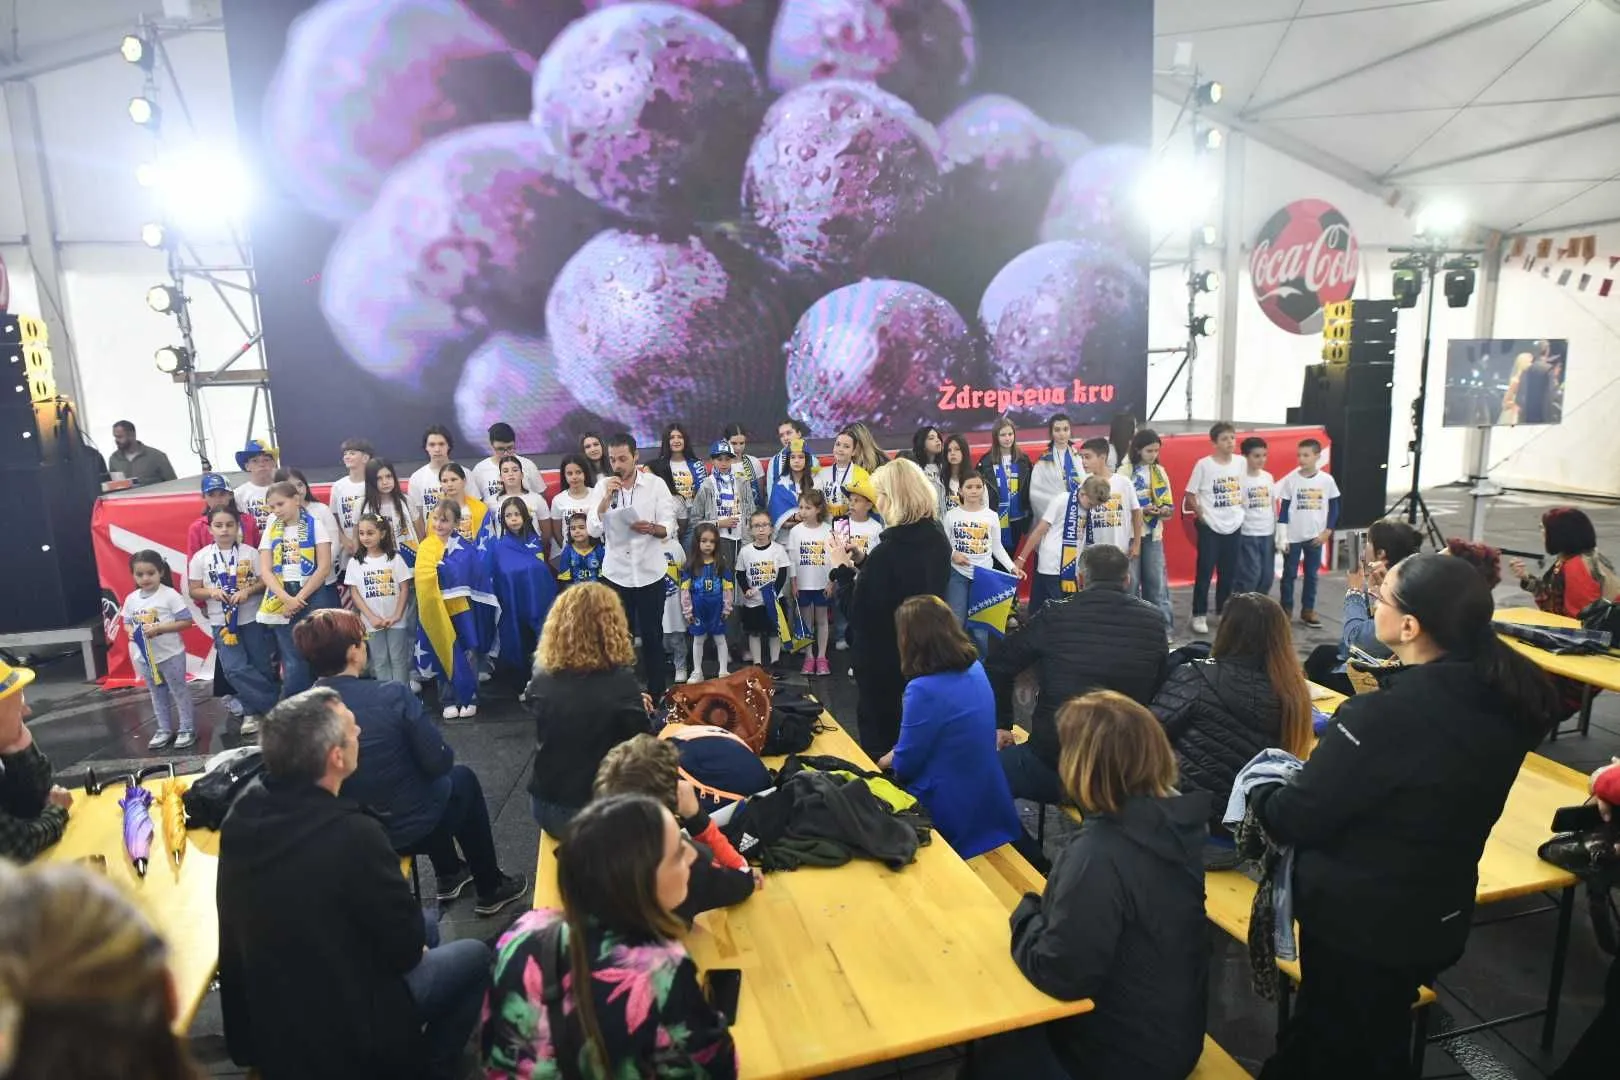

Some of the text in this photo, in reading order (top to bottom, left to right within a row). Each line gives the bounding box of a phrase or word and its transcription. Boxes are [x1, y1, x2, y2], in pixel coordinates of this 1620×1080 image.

[938, 379, 1114, 413] Ždrepčeva krv
[1066, 504, 1078, 539] HAJMO
[704, 579, 713, 591] 19
